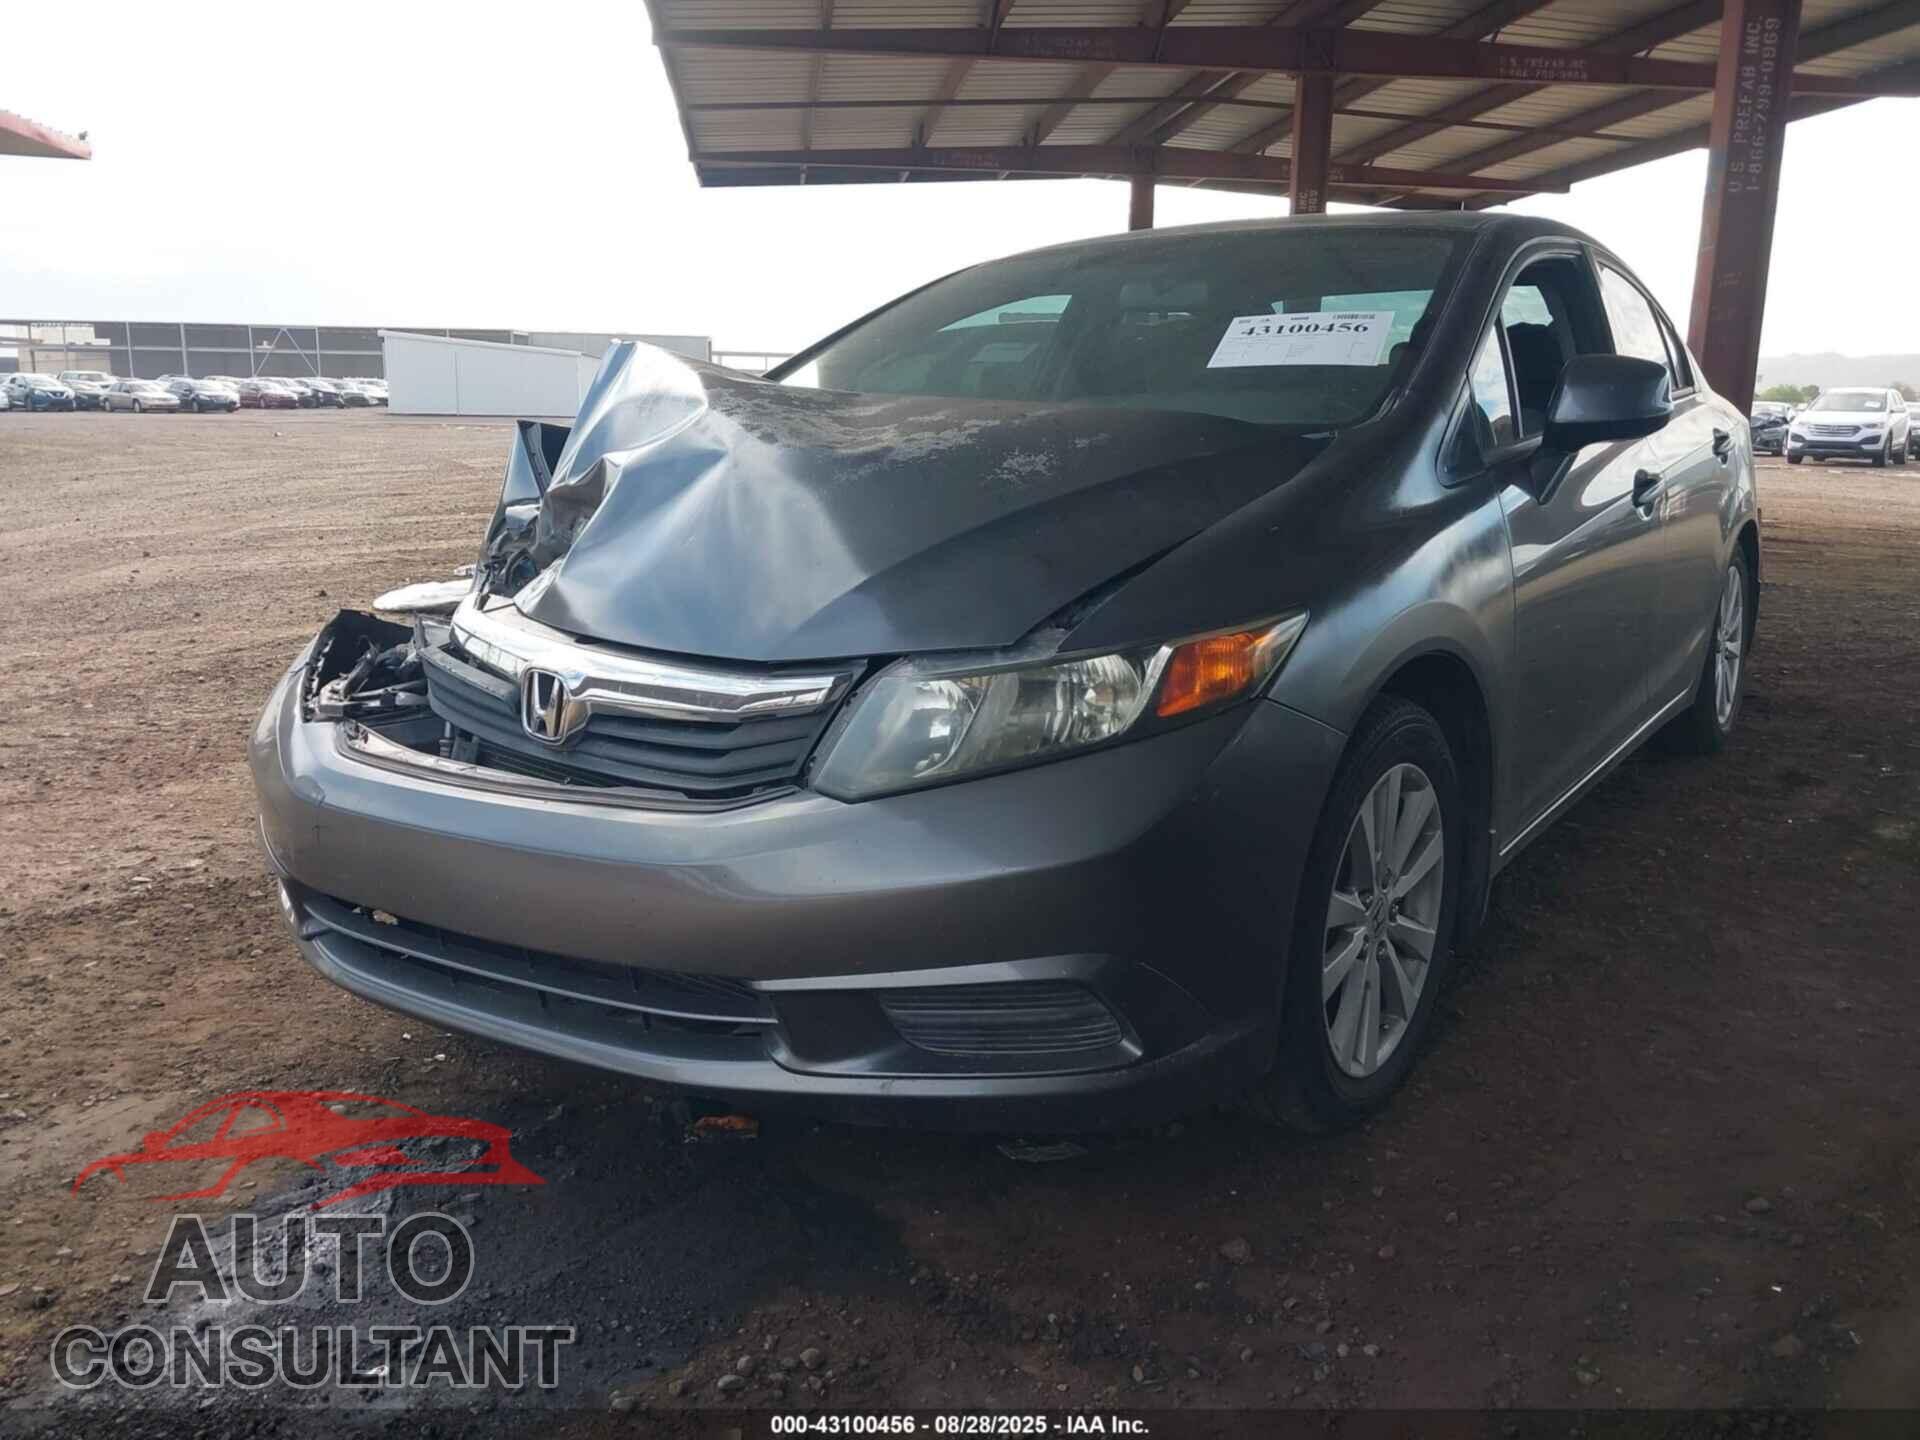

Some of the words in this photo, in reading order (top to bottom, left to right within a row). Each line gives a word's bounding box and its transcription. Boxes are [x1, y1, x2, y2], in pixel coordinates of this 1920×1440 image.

[1732, 65, 1757, 144] PREFAB
[1745, 17, 1782, 191] 1-866-799-0969
[1240, 322, 1369, 337] 43100456
